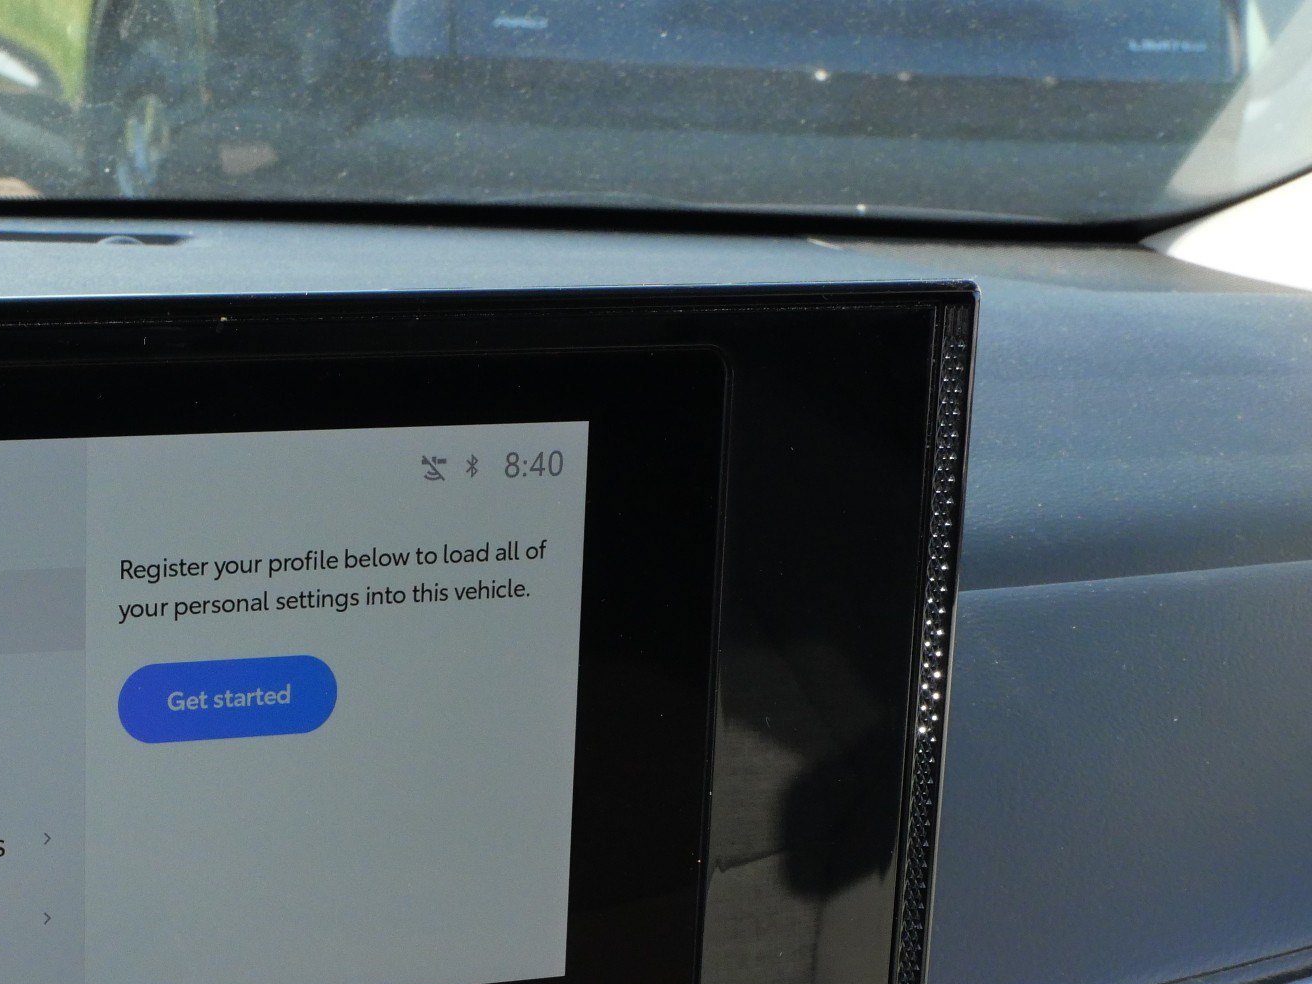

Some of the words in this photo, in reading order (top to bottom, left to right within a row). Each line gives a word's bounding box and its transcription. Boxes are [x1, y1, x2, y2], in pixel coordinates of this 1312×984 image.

[504, 450, 564, 479] 8:40
[120, 558, 209, 584] Register
[214, 558, 263, 581] your
[268, 549, 339, 578] profile
[344, 547, 410, 569] below
[416, 548, 437, 565] to
[443, 542, 489, 564] load
[495, 541, 520, 561] all
[525, 539, 547, 560] of
[118, 602, 168, 624] your
[174, 591, 269, 621] personal
[275, 589, 360, 612] settings
[366, 586, 406, 606] into
[412, 583, 448, 603] this
[454, 578, 530, 600] vehicle.
[167, 691, 208, 712] Get
[213, 684, 291, 709] started
